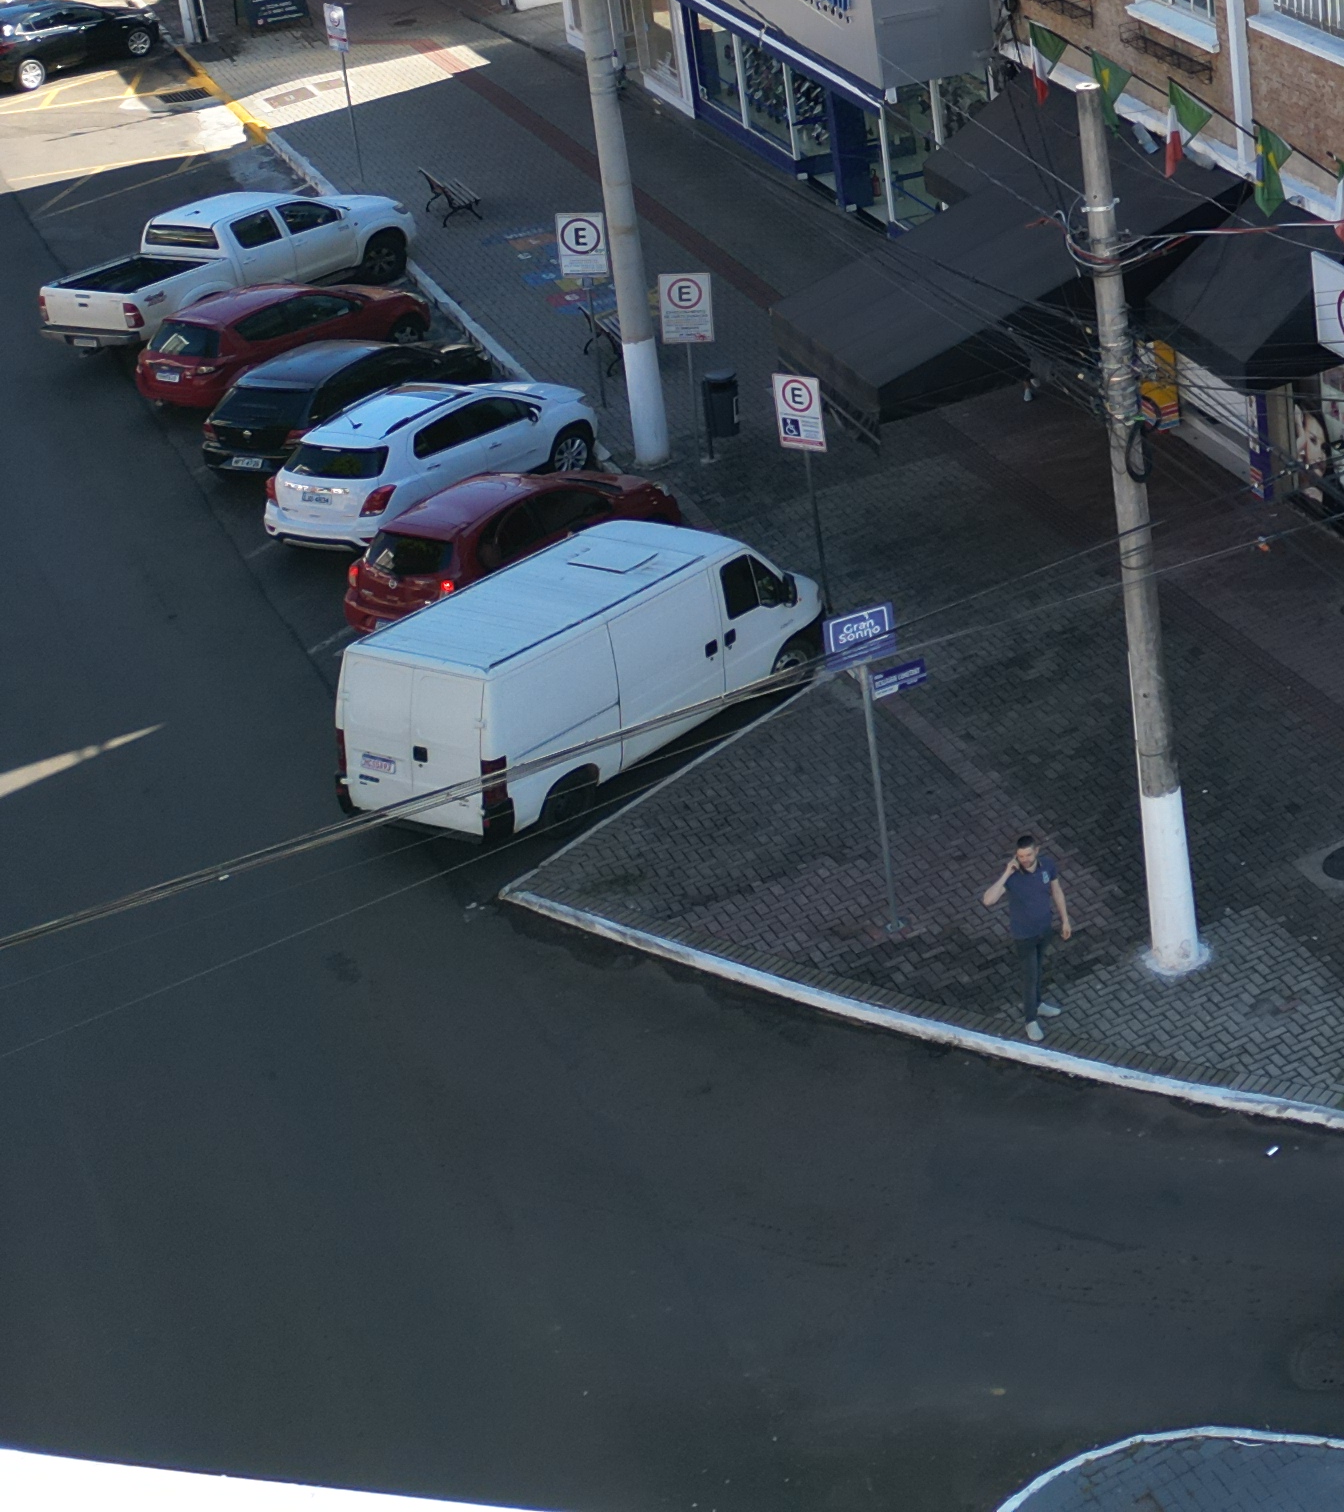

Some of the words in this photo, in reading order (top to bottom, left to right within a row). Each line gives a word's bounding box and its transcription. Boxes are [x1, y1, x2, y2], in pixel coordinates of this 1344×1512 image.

[573, 227, 588, 246] E
[677, 285, 692, 303] E
[790, 386, 804, 406] E
